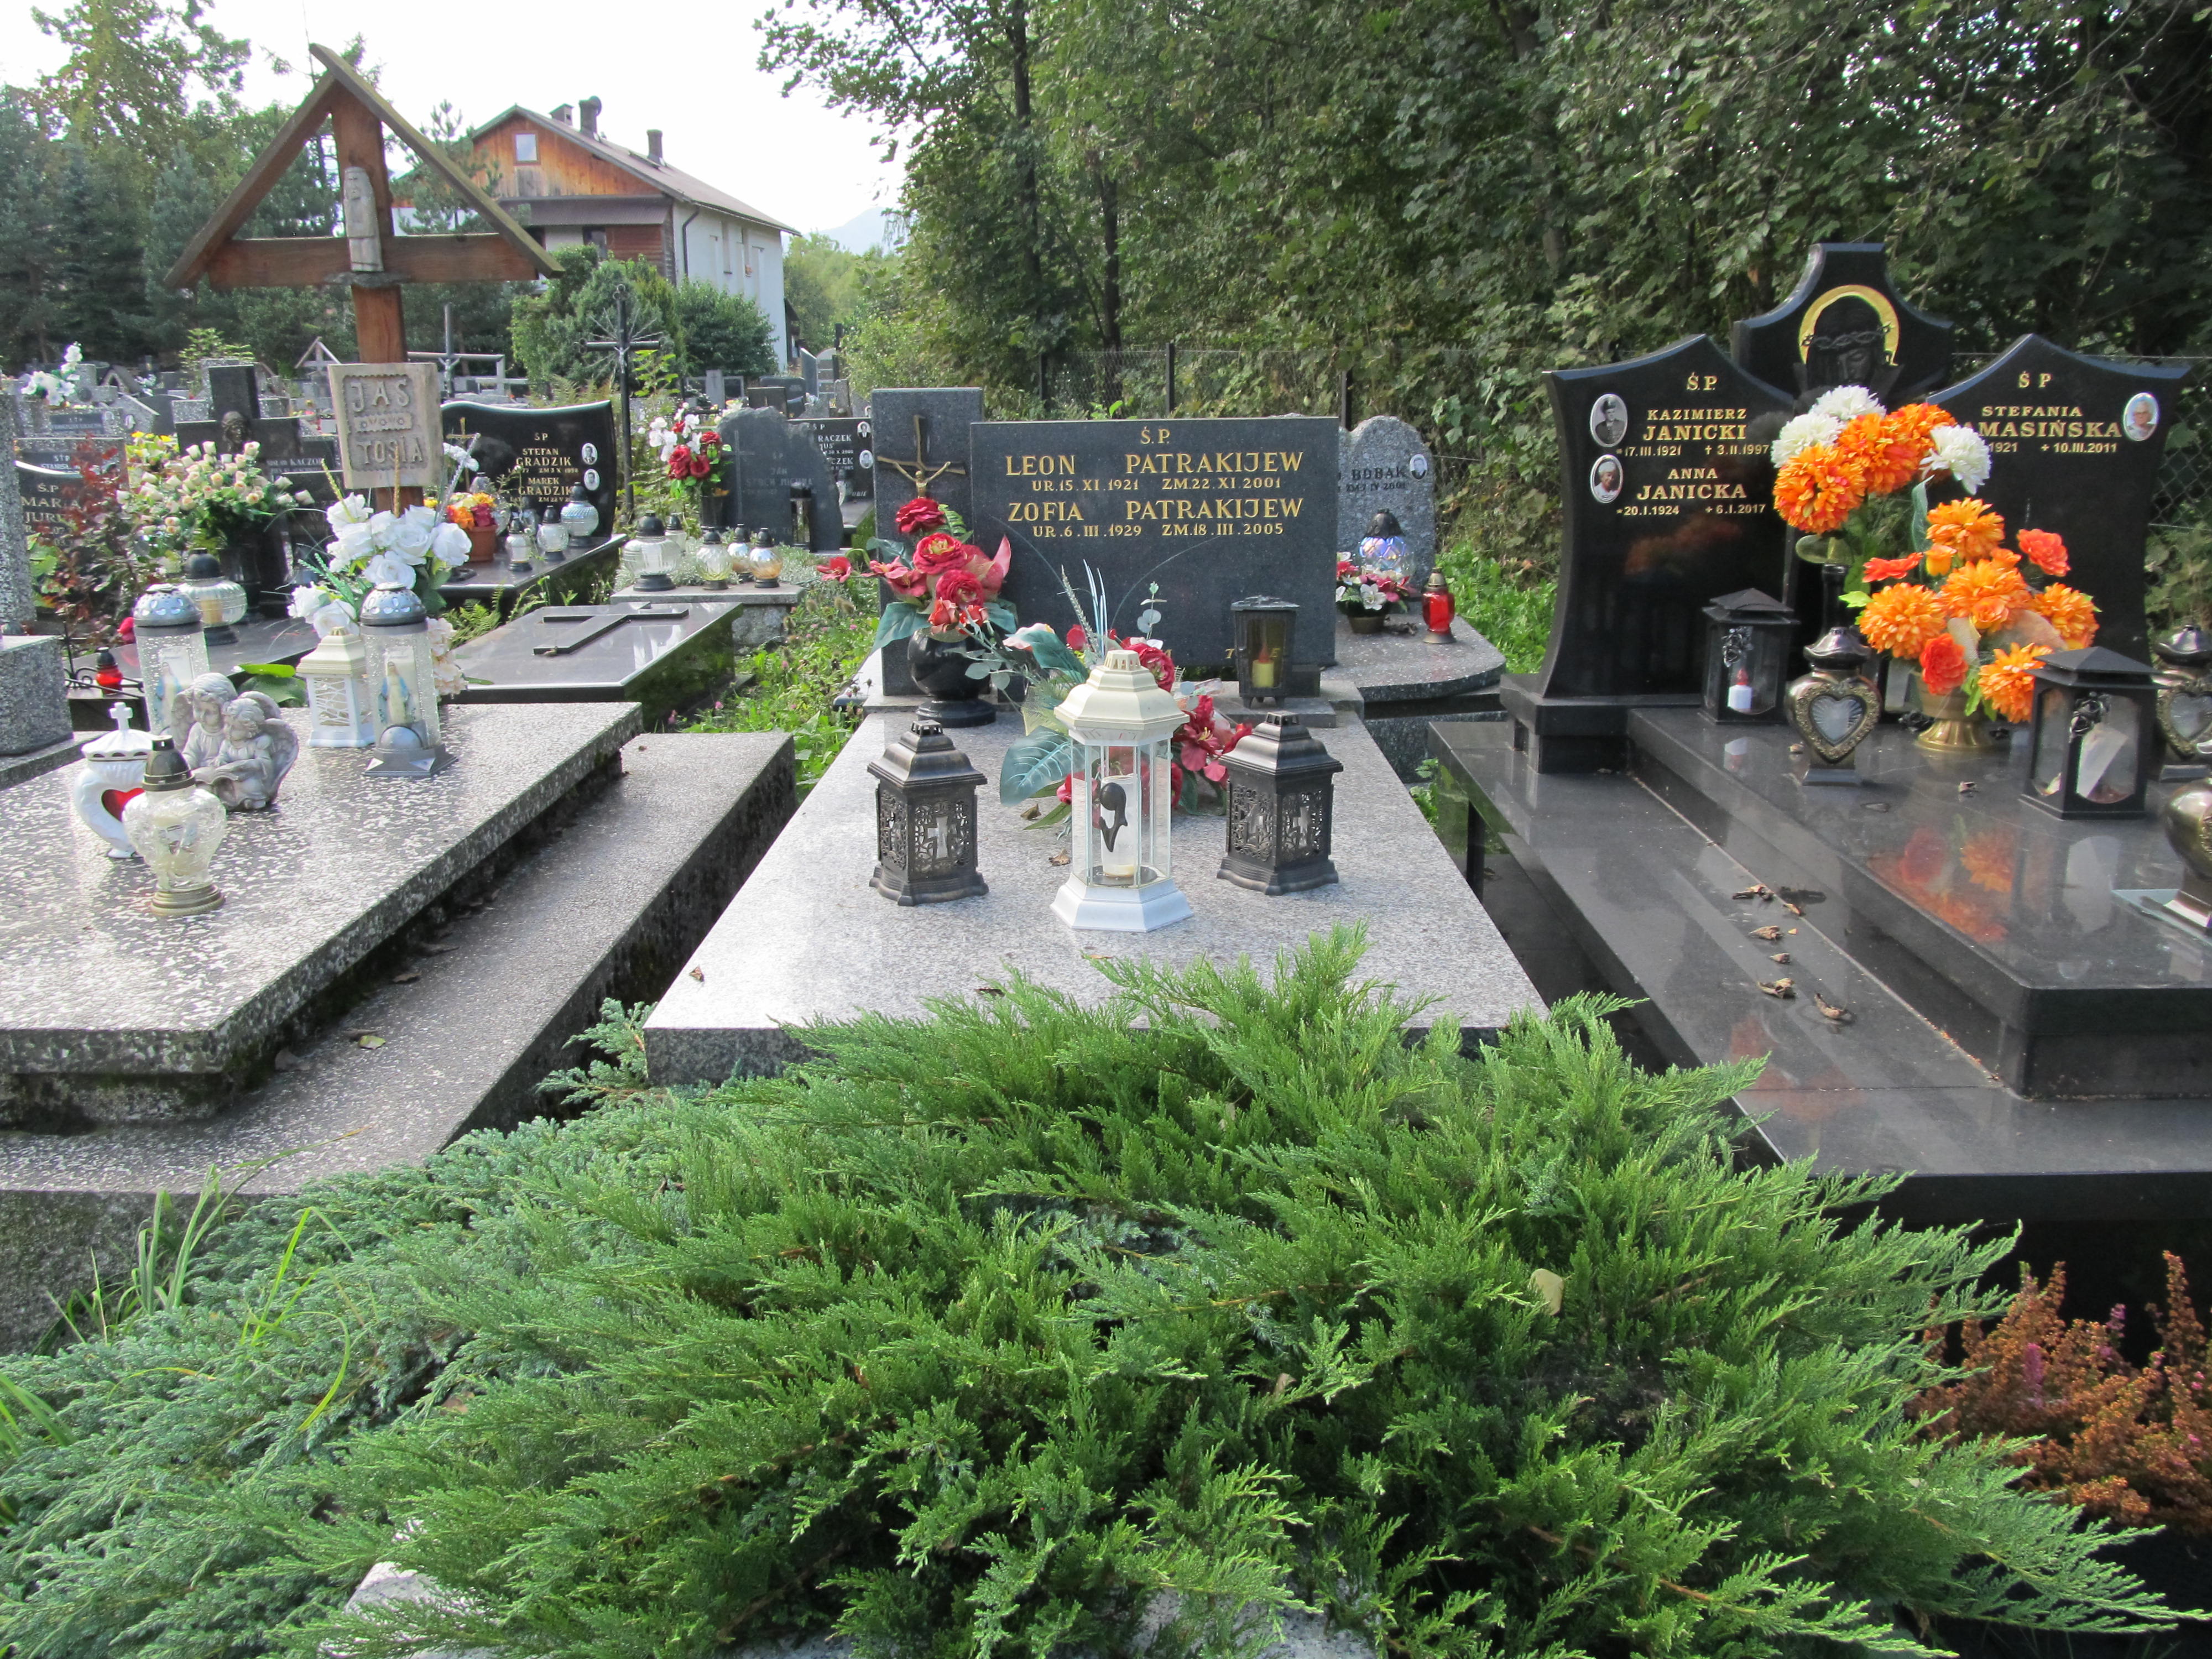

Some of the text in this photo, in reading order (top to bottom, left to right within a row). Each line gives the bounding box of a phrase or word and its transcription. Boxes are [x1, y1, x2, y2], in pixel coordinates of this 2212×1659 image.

[1646, 408, 1747, 421] KAZIMIERZ
[1981, 405, 2084, 417] STEFANIA
[1642, 424, 1747, 441] JANICKI
[1965, 419, 2123, 438] MASIŃSKA
[817, 434, 852, 442] RACZEK
[515, 456, 572, 467] GRADZIK
[1005, 451, 1304, 476] LEON PATRAKIJEW
[1667, 468, 1718, 479] ANNA
[1636, 484, 1747, 500] JANICKA
[1007, 497, 1304, 522] ZOFIA PATRAKIJEW
